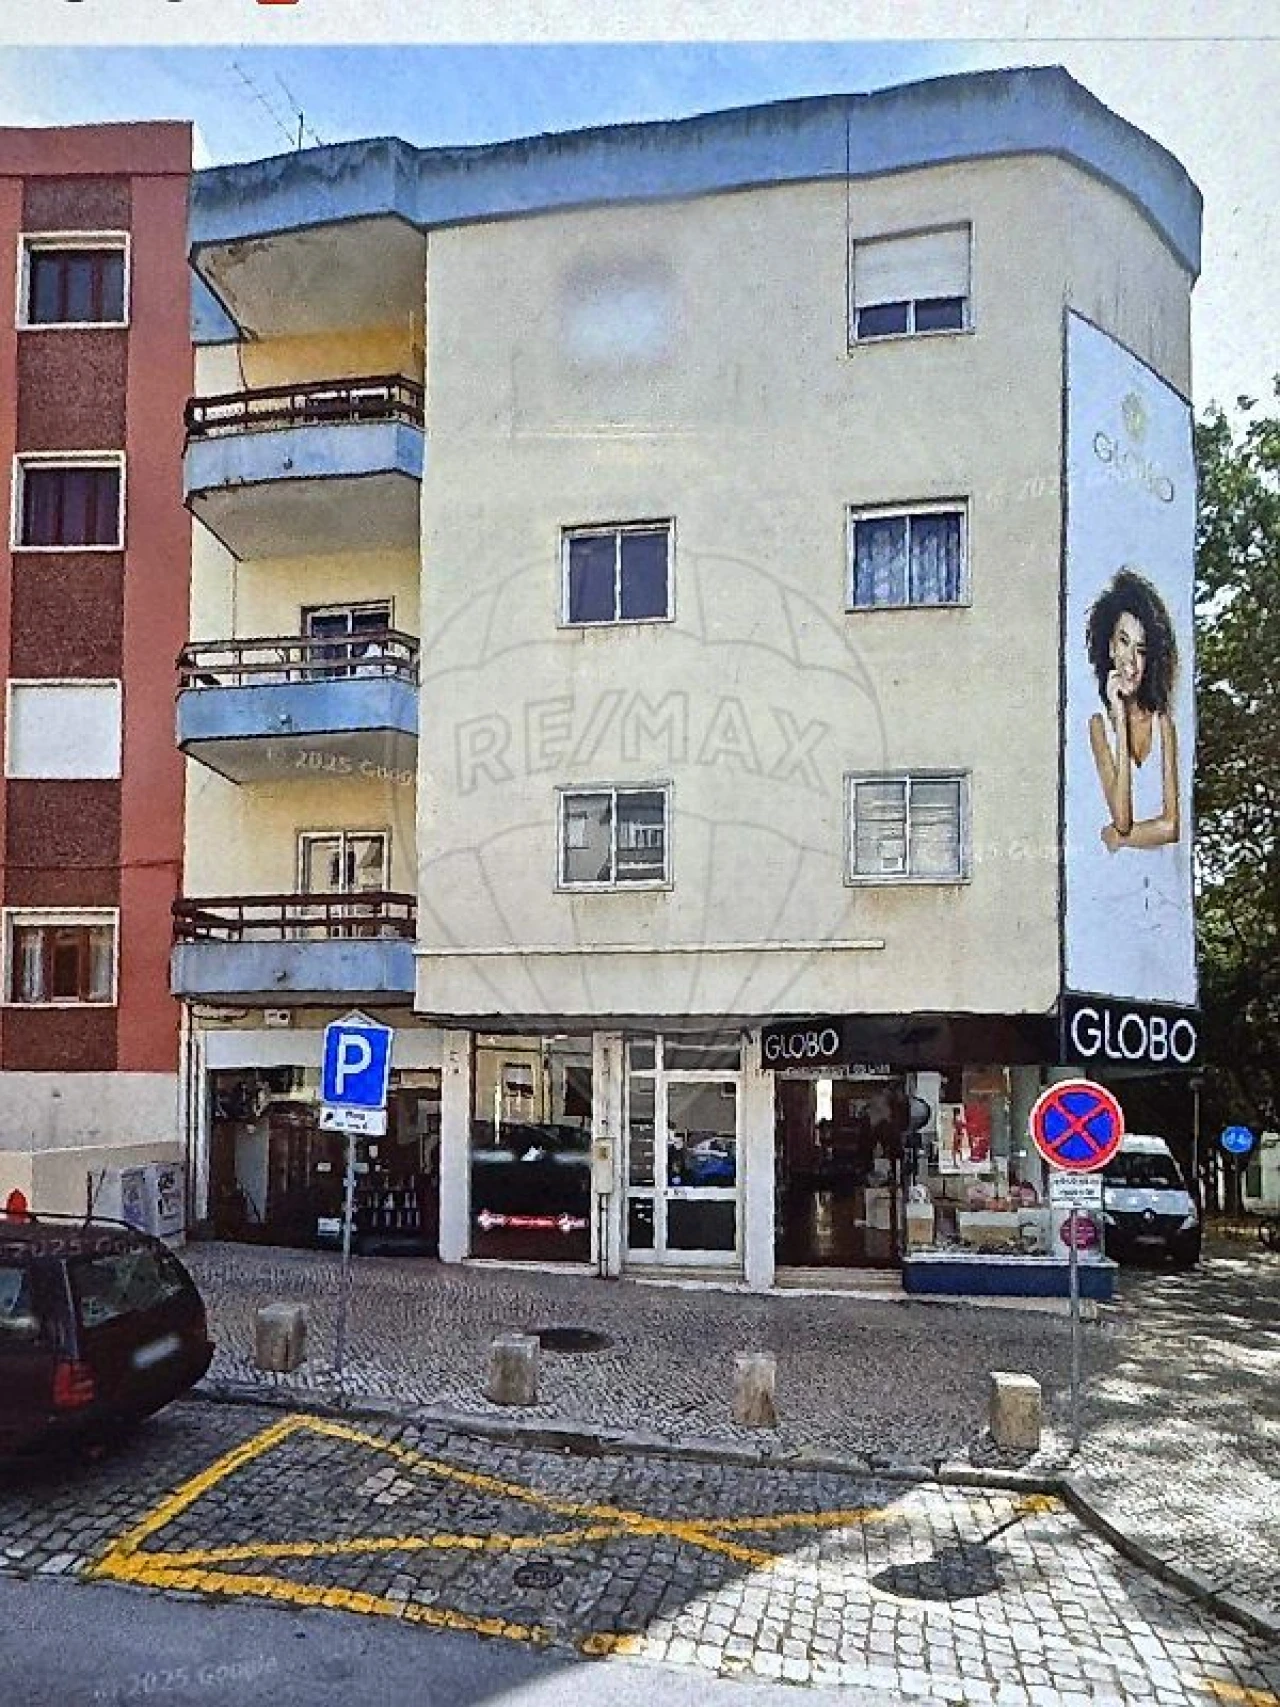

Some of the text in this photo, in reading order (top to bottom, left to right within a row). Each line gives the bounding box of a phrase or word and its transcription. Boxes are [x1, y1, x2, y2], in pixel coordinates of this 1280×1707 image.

[765, 1028, 839, 1060] GLOBO
[1071, 1007, 1198, 1063] GLOBO
[334, 1032, 372, 1096] P
